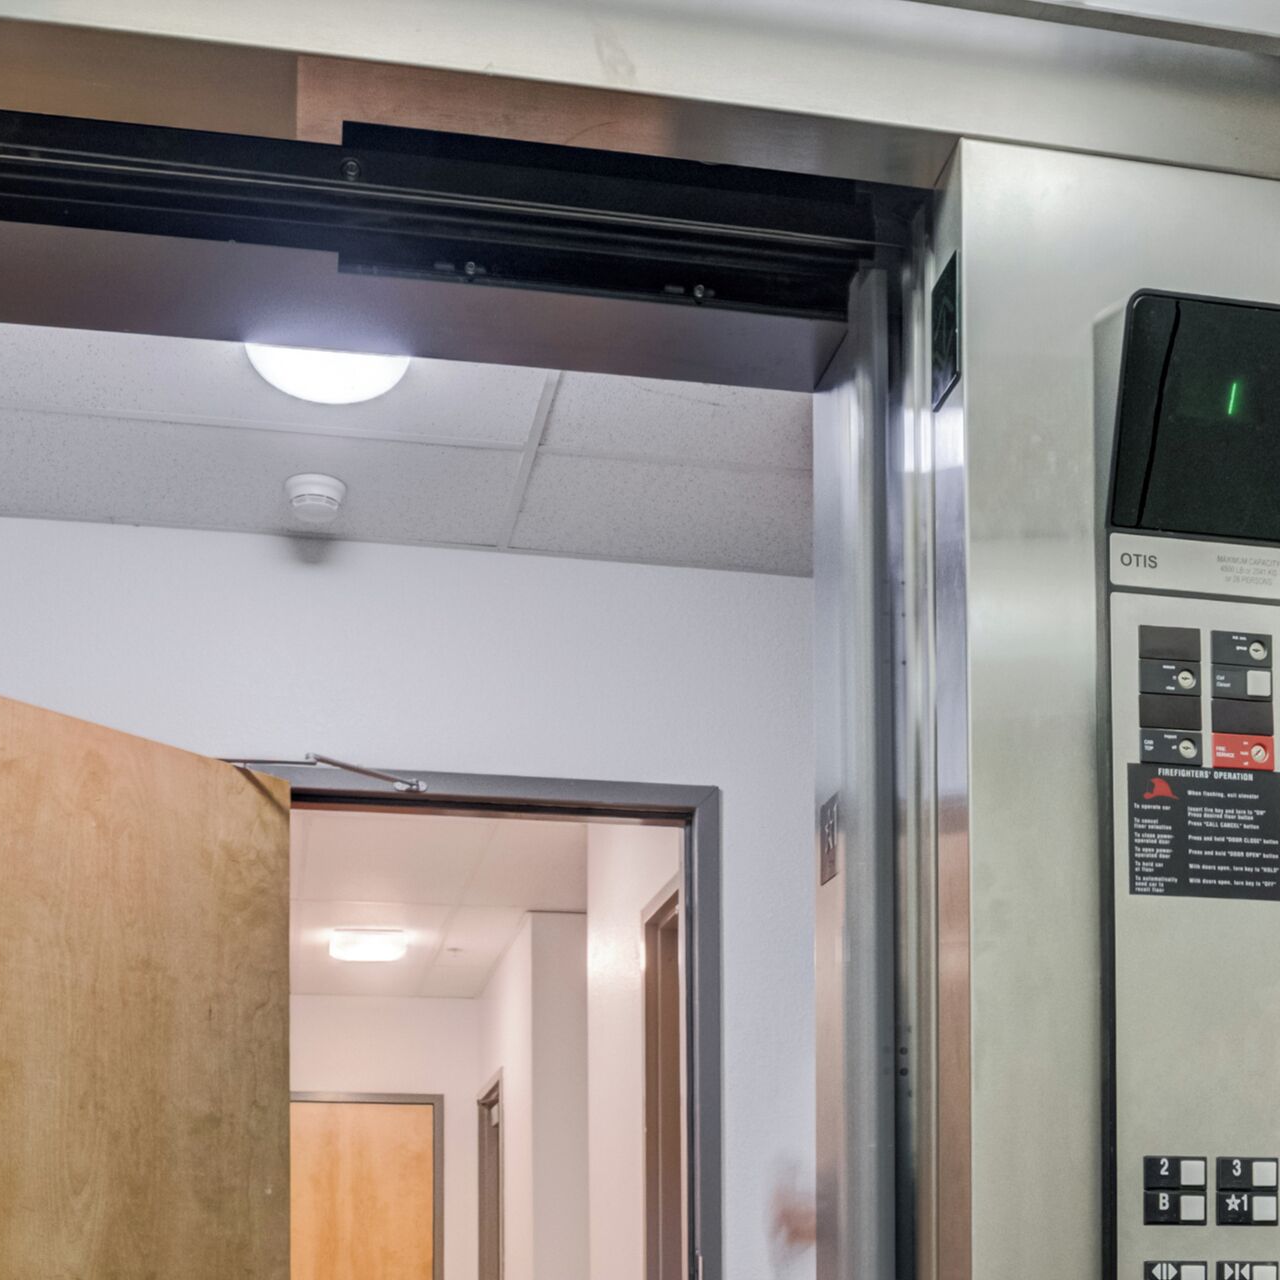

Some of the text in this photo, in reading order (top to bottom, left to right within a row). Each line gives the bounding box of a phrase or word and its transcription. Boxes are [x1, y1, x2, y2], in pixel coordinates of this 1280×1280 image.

[1120, 553, 1157, 568] OTIS
[1249, 558, 1280, 567] CAPACITY
[1158, 767, 1253, 781] FIREFIGHTERS' OPERATION
[1160, 1158, 1169, 1175] 2
[1232, 1159, 1241, 1176] 3
[1159, 1193, 1169, 1210] B
